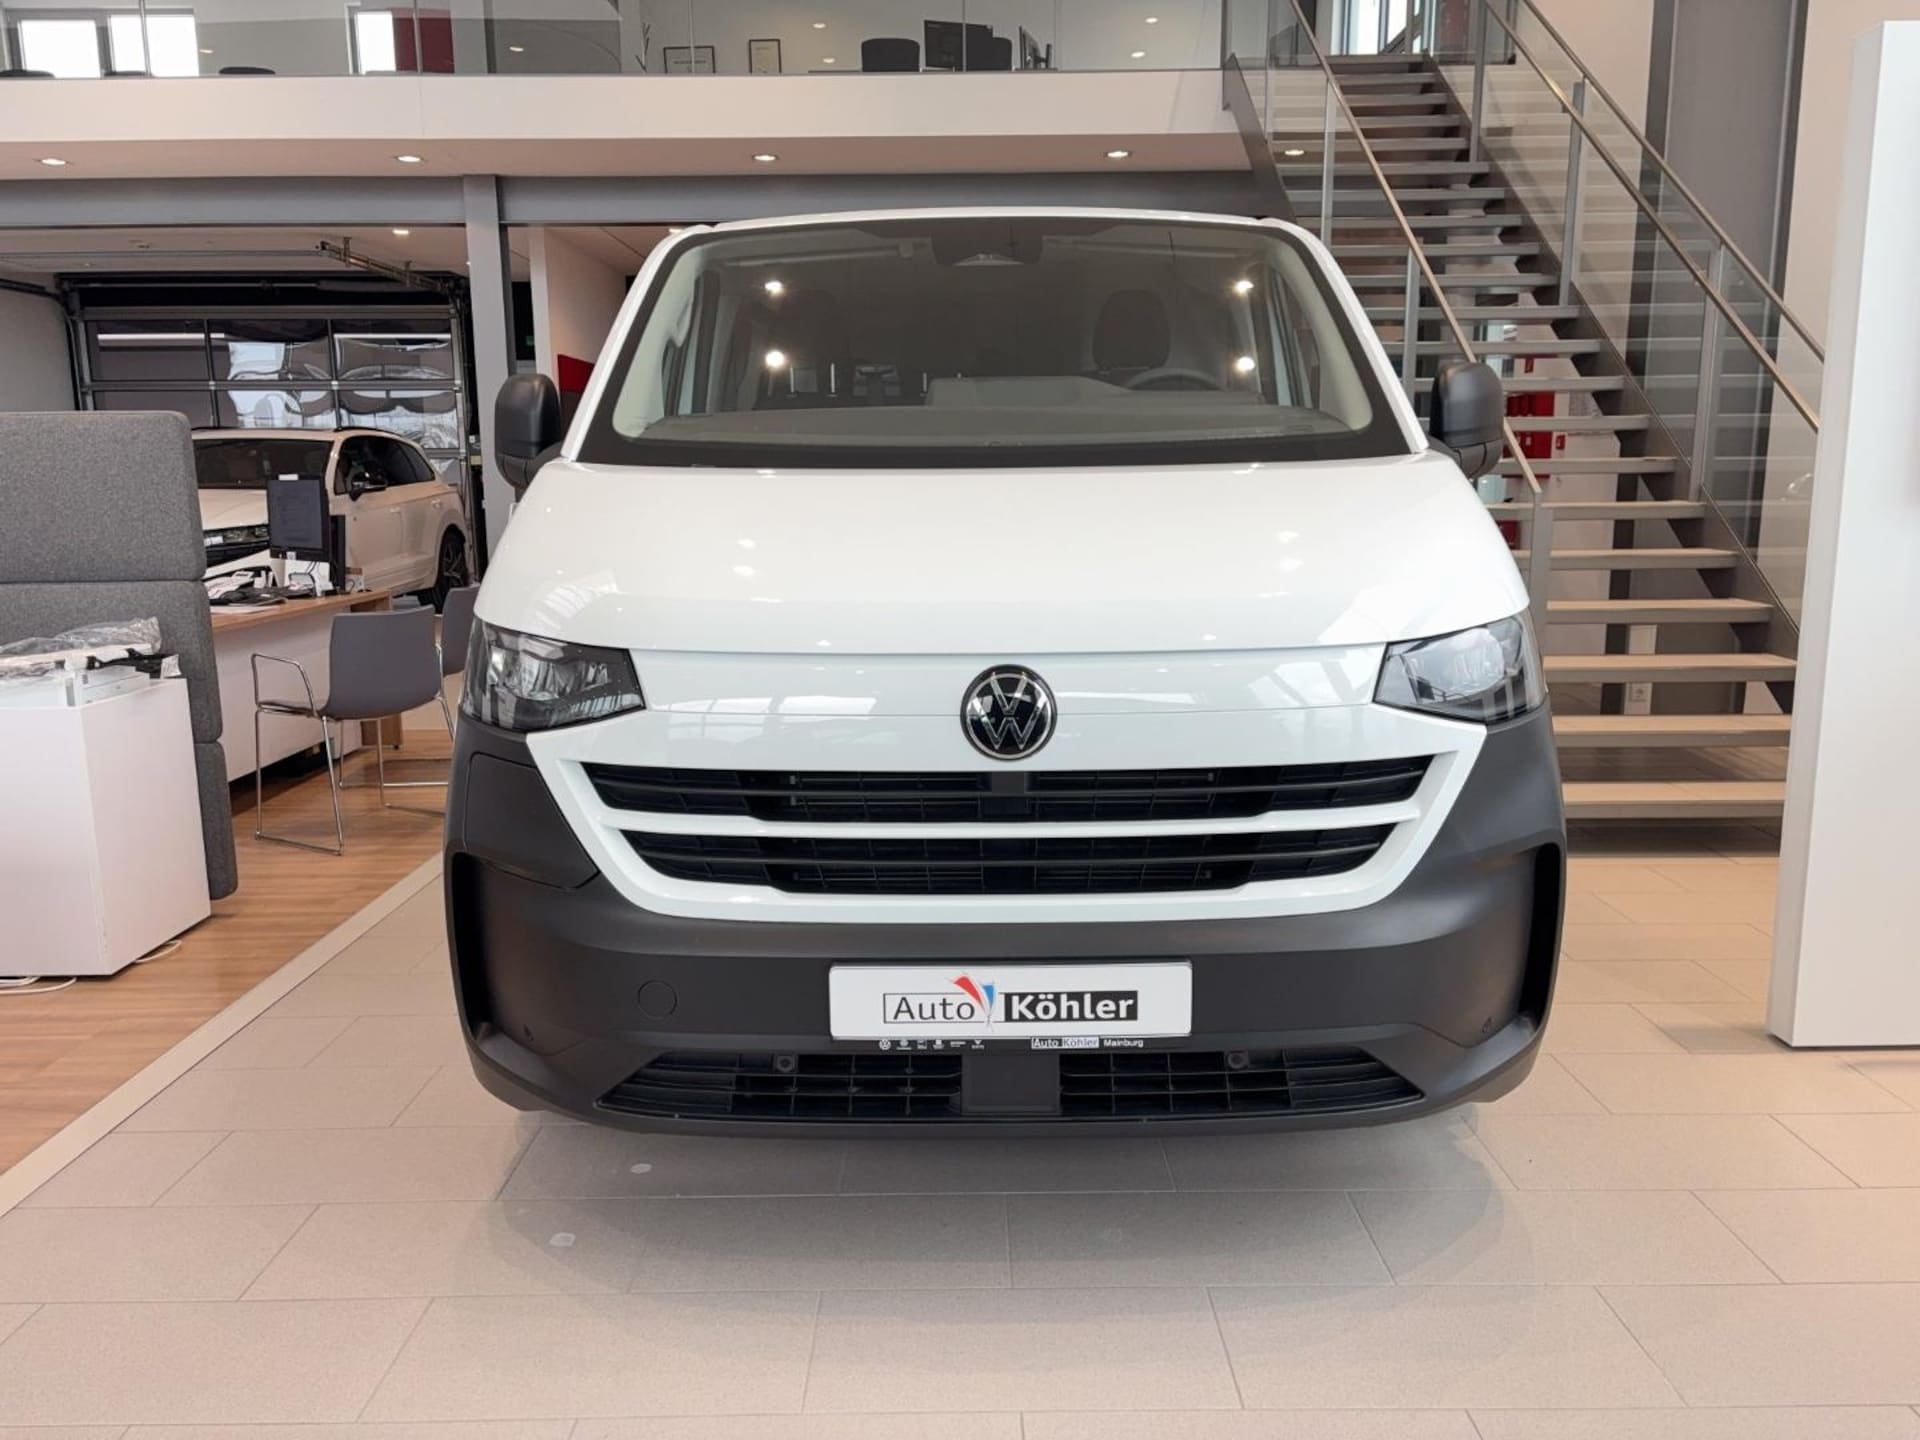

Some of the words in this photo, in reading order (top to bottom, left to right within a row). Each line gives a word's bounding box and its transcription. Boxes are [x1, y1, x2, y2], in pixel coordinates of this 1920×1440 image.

[972, 672, 1047, 750] VW
[893, 996, 975, 1020] Auto
[1011, 993, 1134, 1020] Köhler
[1033, 1039, 1060, 1048] Auto
[1063, 1037, 1098, 1048] Köhler
[1103, 1039, 1144, 1048] Mainburg
